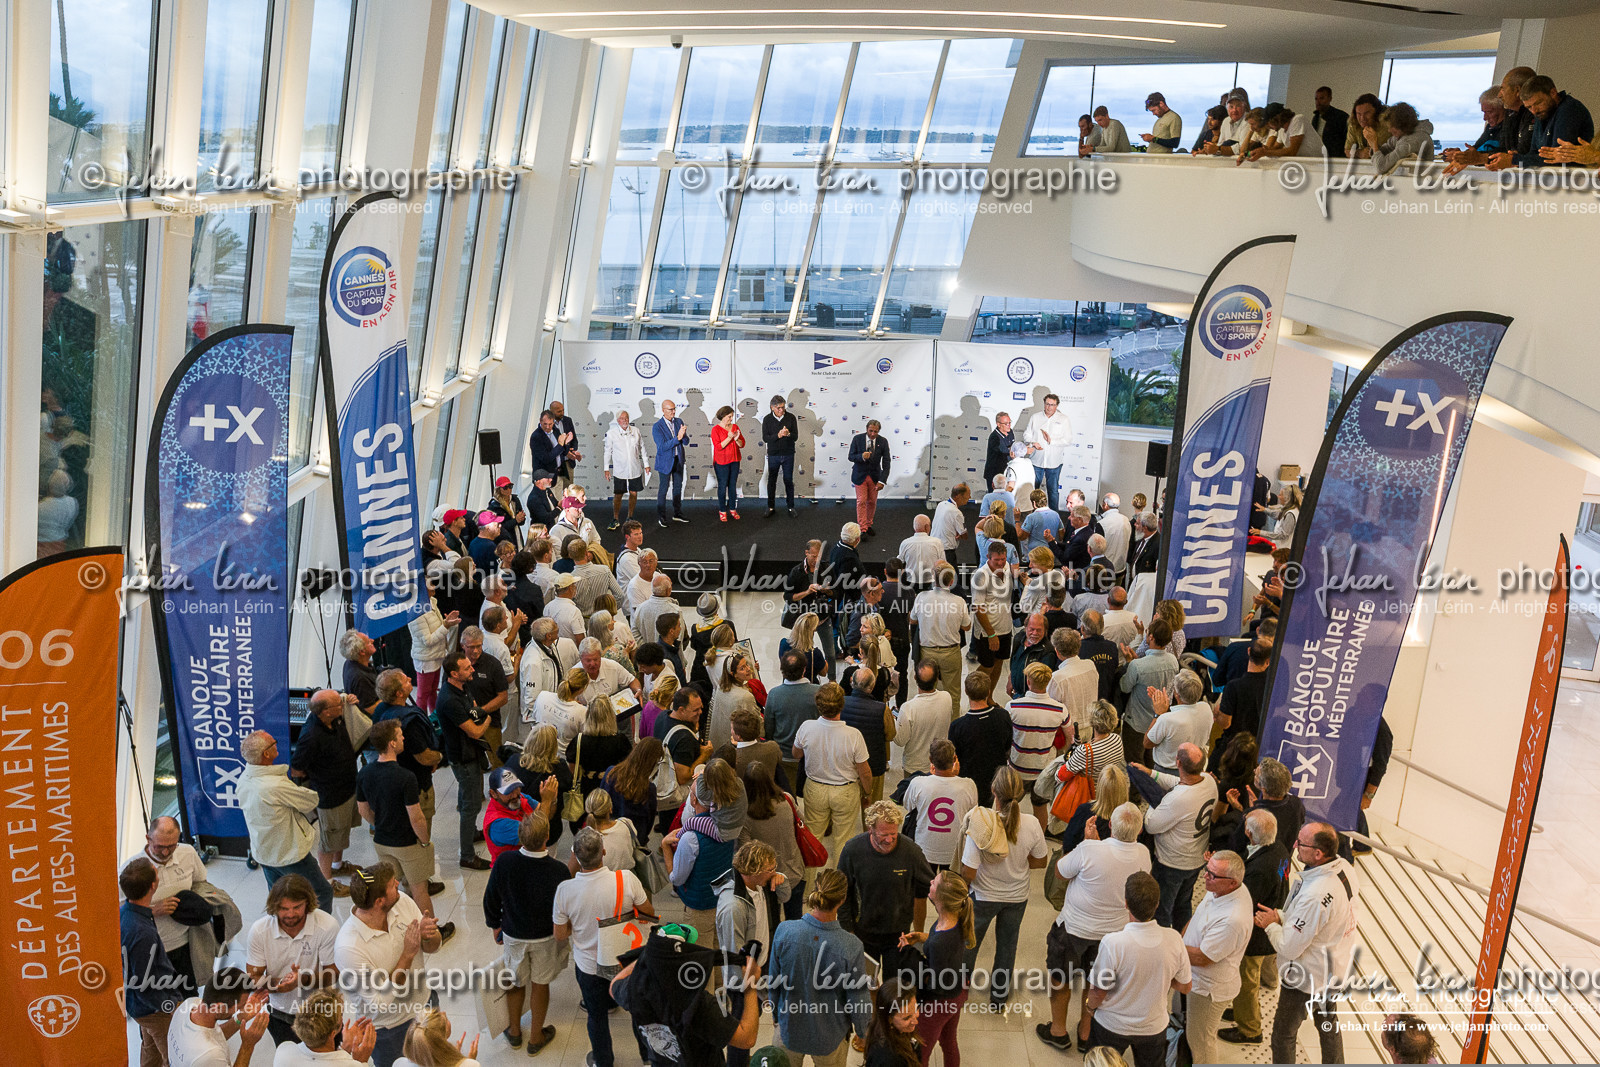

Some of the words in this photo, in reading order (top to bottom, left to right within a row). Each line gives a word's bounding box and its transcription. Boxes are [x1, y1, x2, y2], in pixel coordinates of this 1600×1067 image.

[344, 273, 385, 286] CANNES
[362, 318, 378, 328] EN
[388, 270, 397, 290] AIR
[347, 300, 360, 308] DU
[1216, 311, 1258, 321] CANNES
[1215, 333, 1227, 341] DU
[1216, 325, 1257, 334] CAPITALE
[1226, 353, 1241, 361] EN
[352, 422, 418, 620] CANNES
[1176, 450, 1245, 625] CANNES
[0, 629, 75, 669] 06
[1305, 607, 1350, 737] POPULAIRE
[1325, 601, 1376, 738] MÉDITERRANÉE
[209, 624, 234, 752] POPULAIRE
[231, 615, 255, 744] ÉDITERRANÉE
[1283, 639, 1321, 736] BANQUE
[190, 655, 214, 751] BANQUE
[43, 701, 79, 923] ALPES-MARITIMES
[928, 797, 955, 827] 6
[1195, 798, 1216, 831] 6
[1, 704, 48, 981] DÉPARTEMENT
[1295, 918, 1306, 929] 12
[1321, 893, 1334, 908] HH
[57, 930, 83, 976] DES
